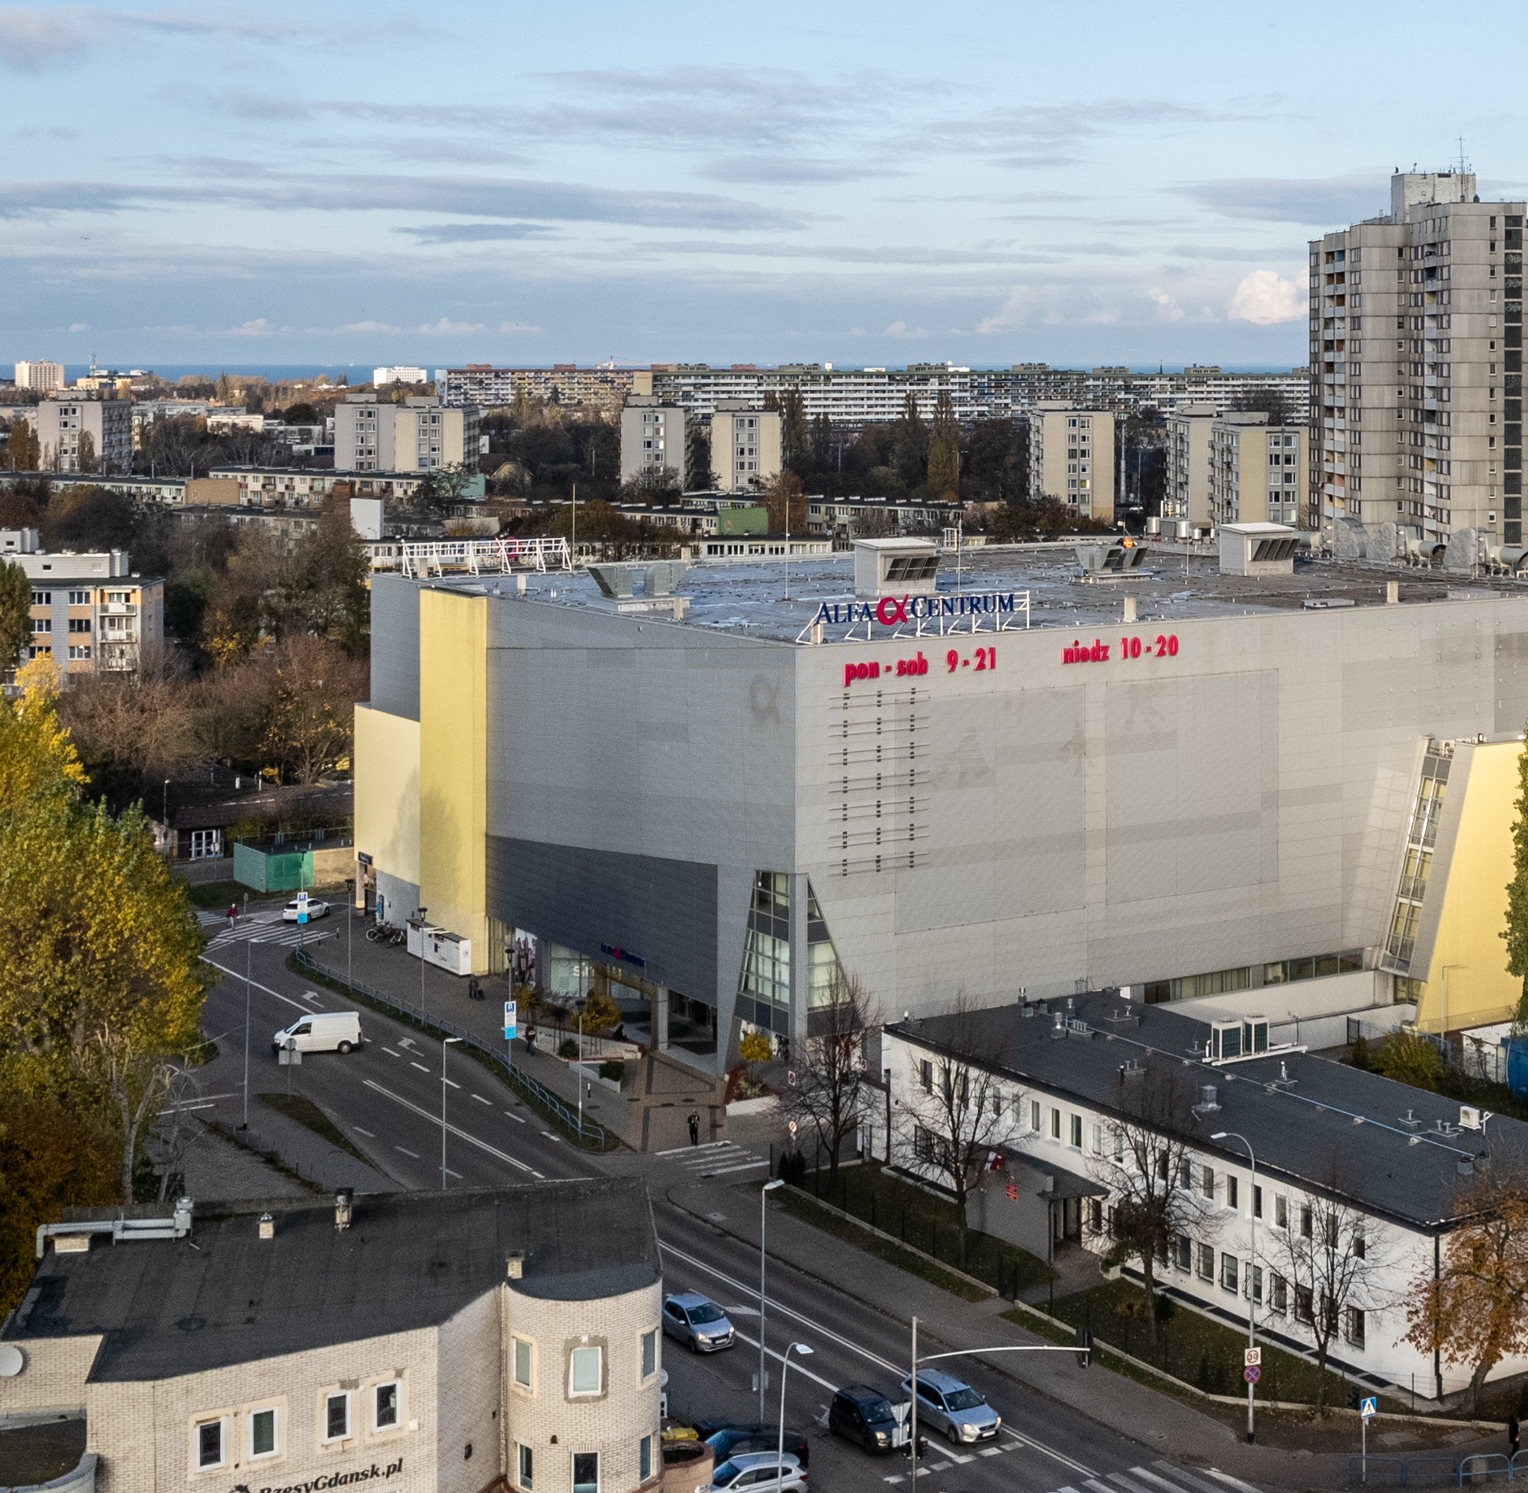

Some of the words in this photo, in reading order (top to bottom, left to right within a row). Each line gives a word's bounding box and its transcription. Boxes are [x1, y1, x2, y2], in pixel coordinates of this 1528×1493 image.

[910, 593, 1015, 619] CENTRUM
[1061, 639, 1109, 664] niedz
[1120, 636, 1141, 659] 10
[1155, 634, 1179, 657] 20
[843, 661, 880, 687] pon
[896, 651, 928, 676] sob
